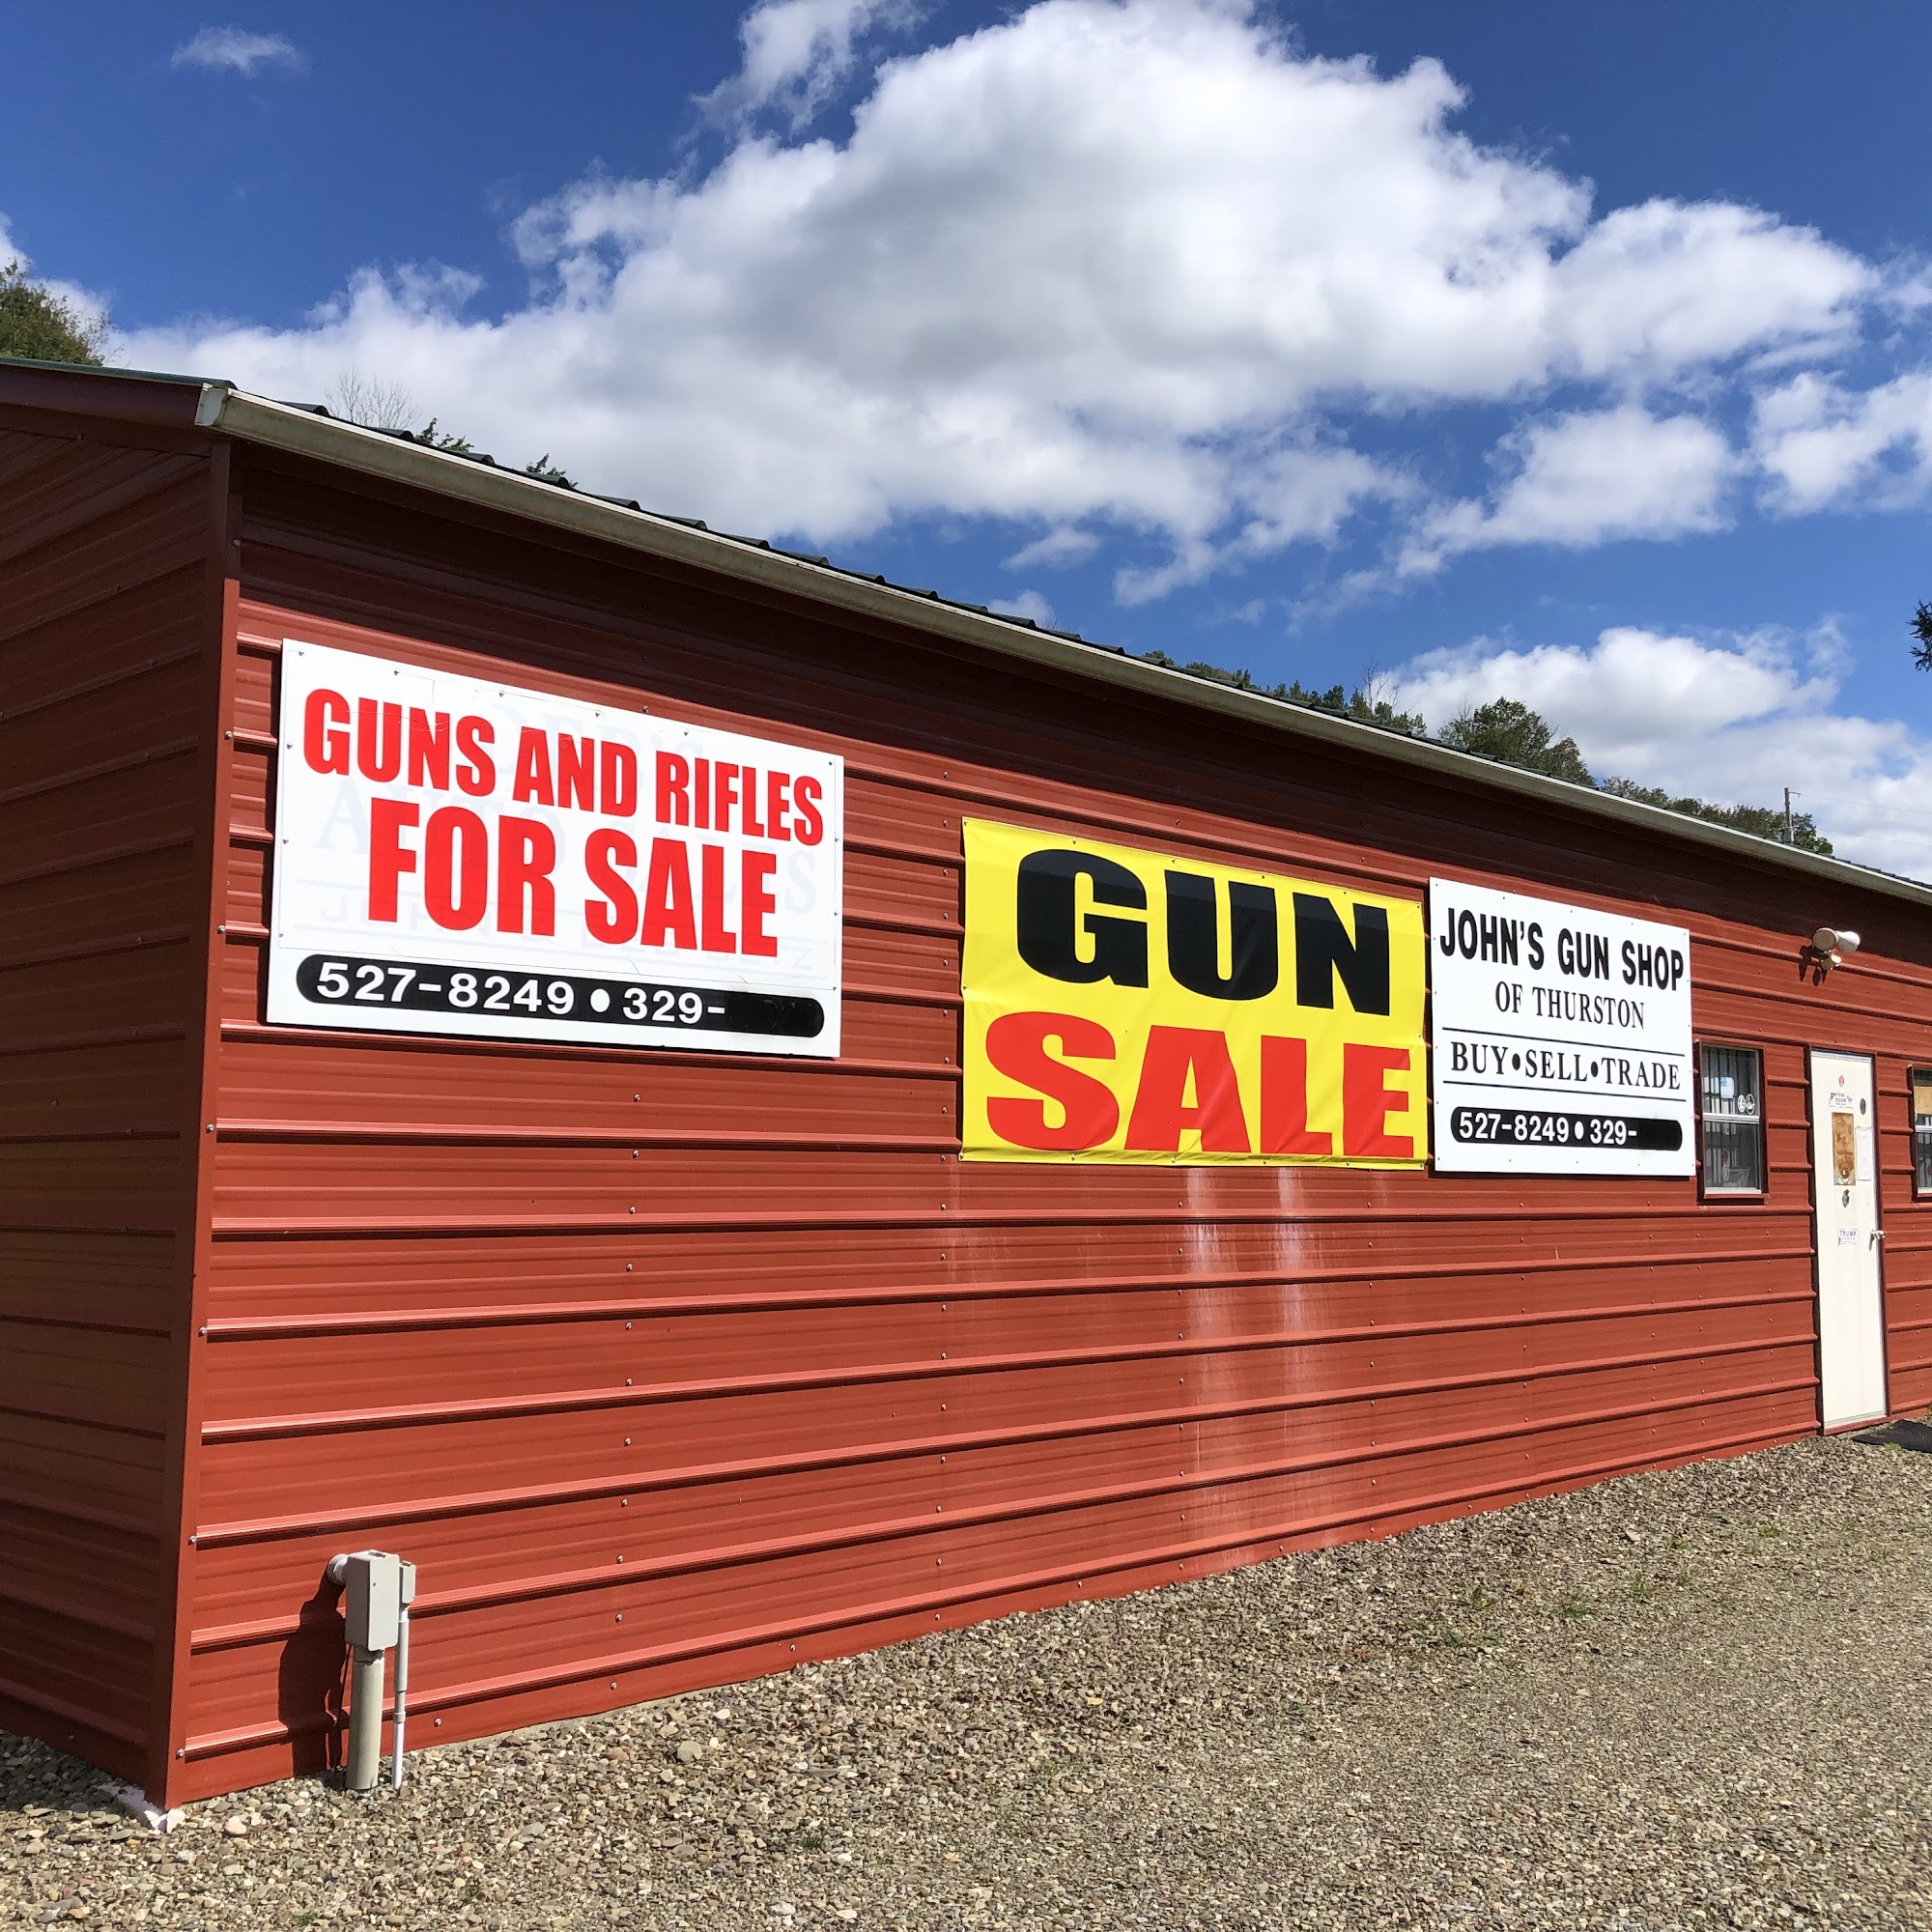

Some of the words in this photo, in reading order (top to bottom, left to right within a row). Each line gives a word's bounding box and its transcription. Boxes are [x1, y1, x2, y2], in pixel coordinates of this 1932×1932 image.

[303, 688, 497, 797] GUNS
[512, 725, 638, 817] AND
[655, 751, 824, 846] RIFLES
[368, 797, 556, 937] FOR
[584, 828, 778, 957] SALE
[1016, 848, 1390, 1017] GUN
[316, 961, 576, 1015] 527-8249
[1439, 907, 1545, 971] JOHN'S
[1557, 927, 1609, 980] GUN
[1621, 940, 1684, 991] SHOP
[1495, 980, 1523, 1013] OF
[1532, 986, 1645, 1030] THURSTON
[985, 1010, 1414, 1159] SALE
[1459, 1111, 1570, 1143] 527-8249
